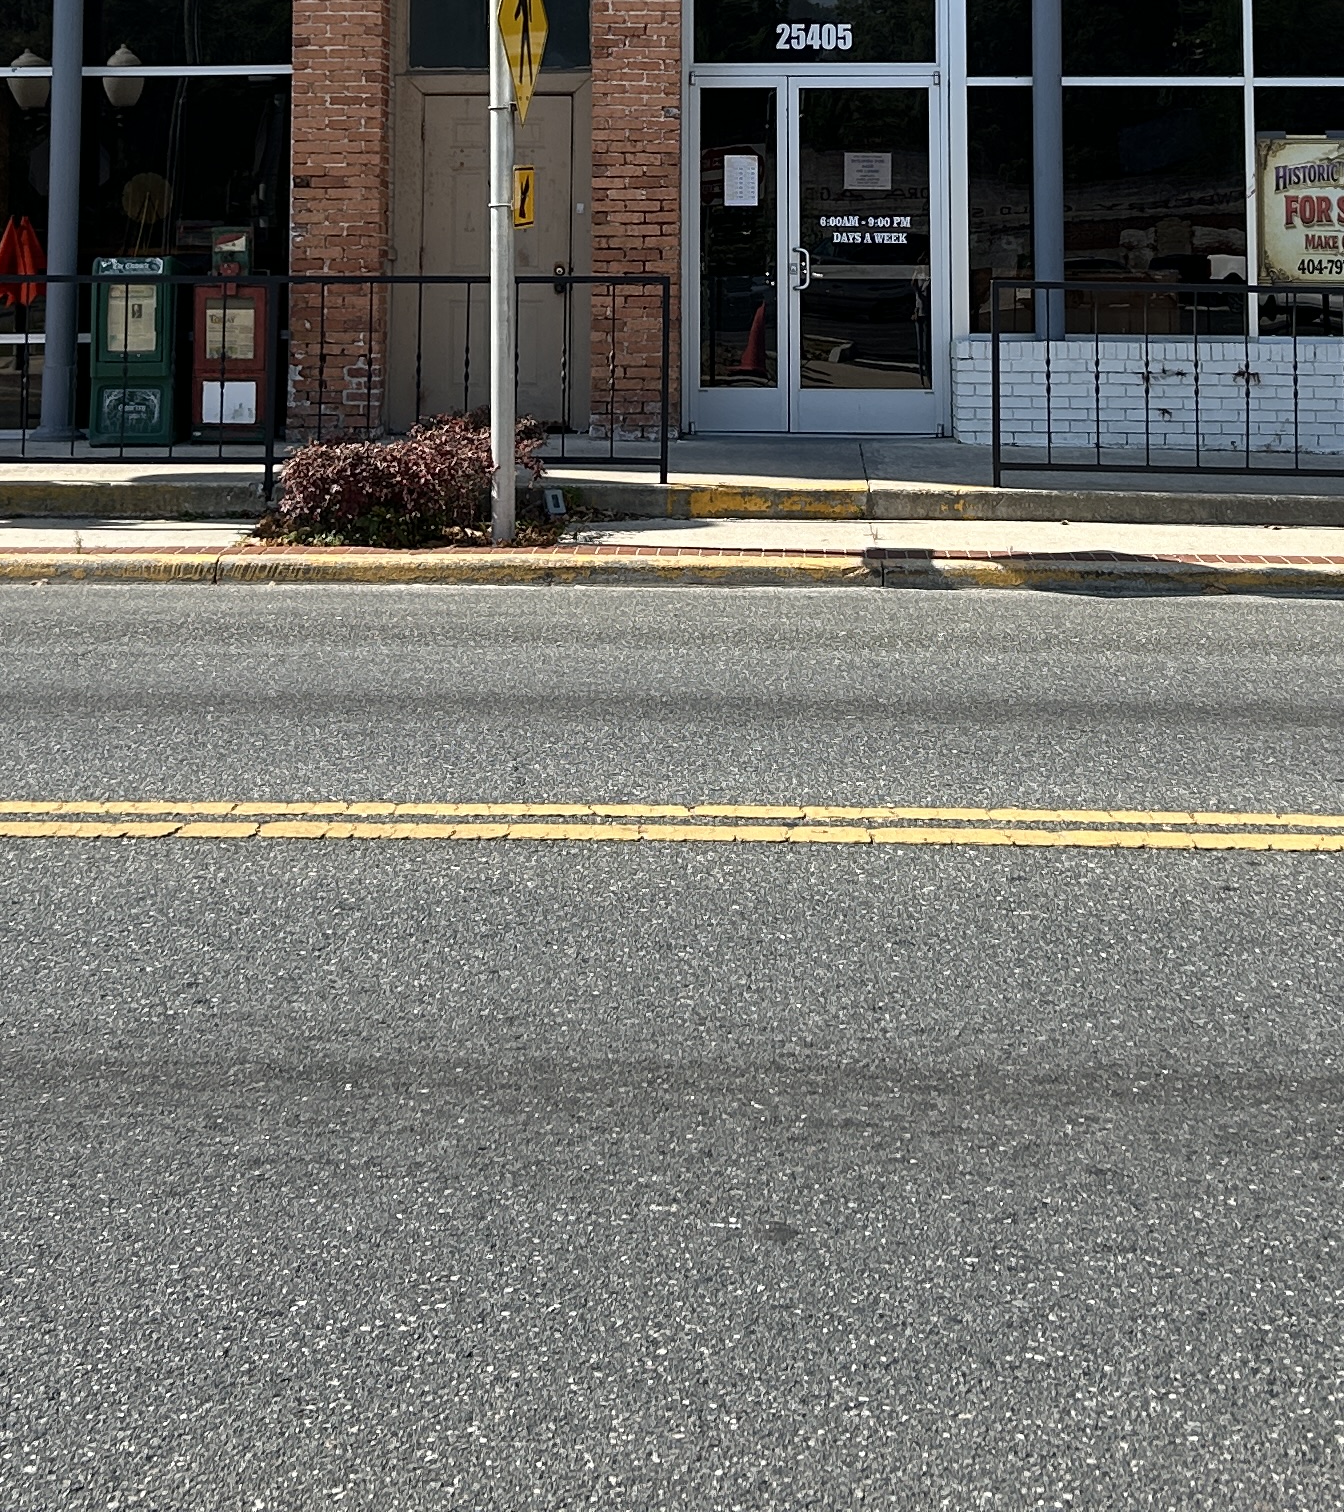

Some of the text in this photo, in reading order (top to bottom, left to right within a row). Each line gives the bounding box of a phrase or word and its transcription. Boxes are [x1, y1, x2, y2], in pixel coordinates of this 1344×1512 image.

[775, 23, 853, 51] 25405
[1284, 195, 1332, 227] FOR
[892, 216, 911, 227] PM
[832, 232, 908, 244] DAYS A WEEK
